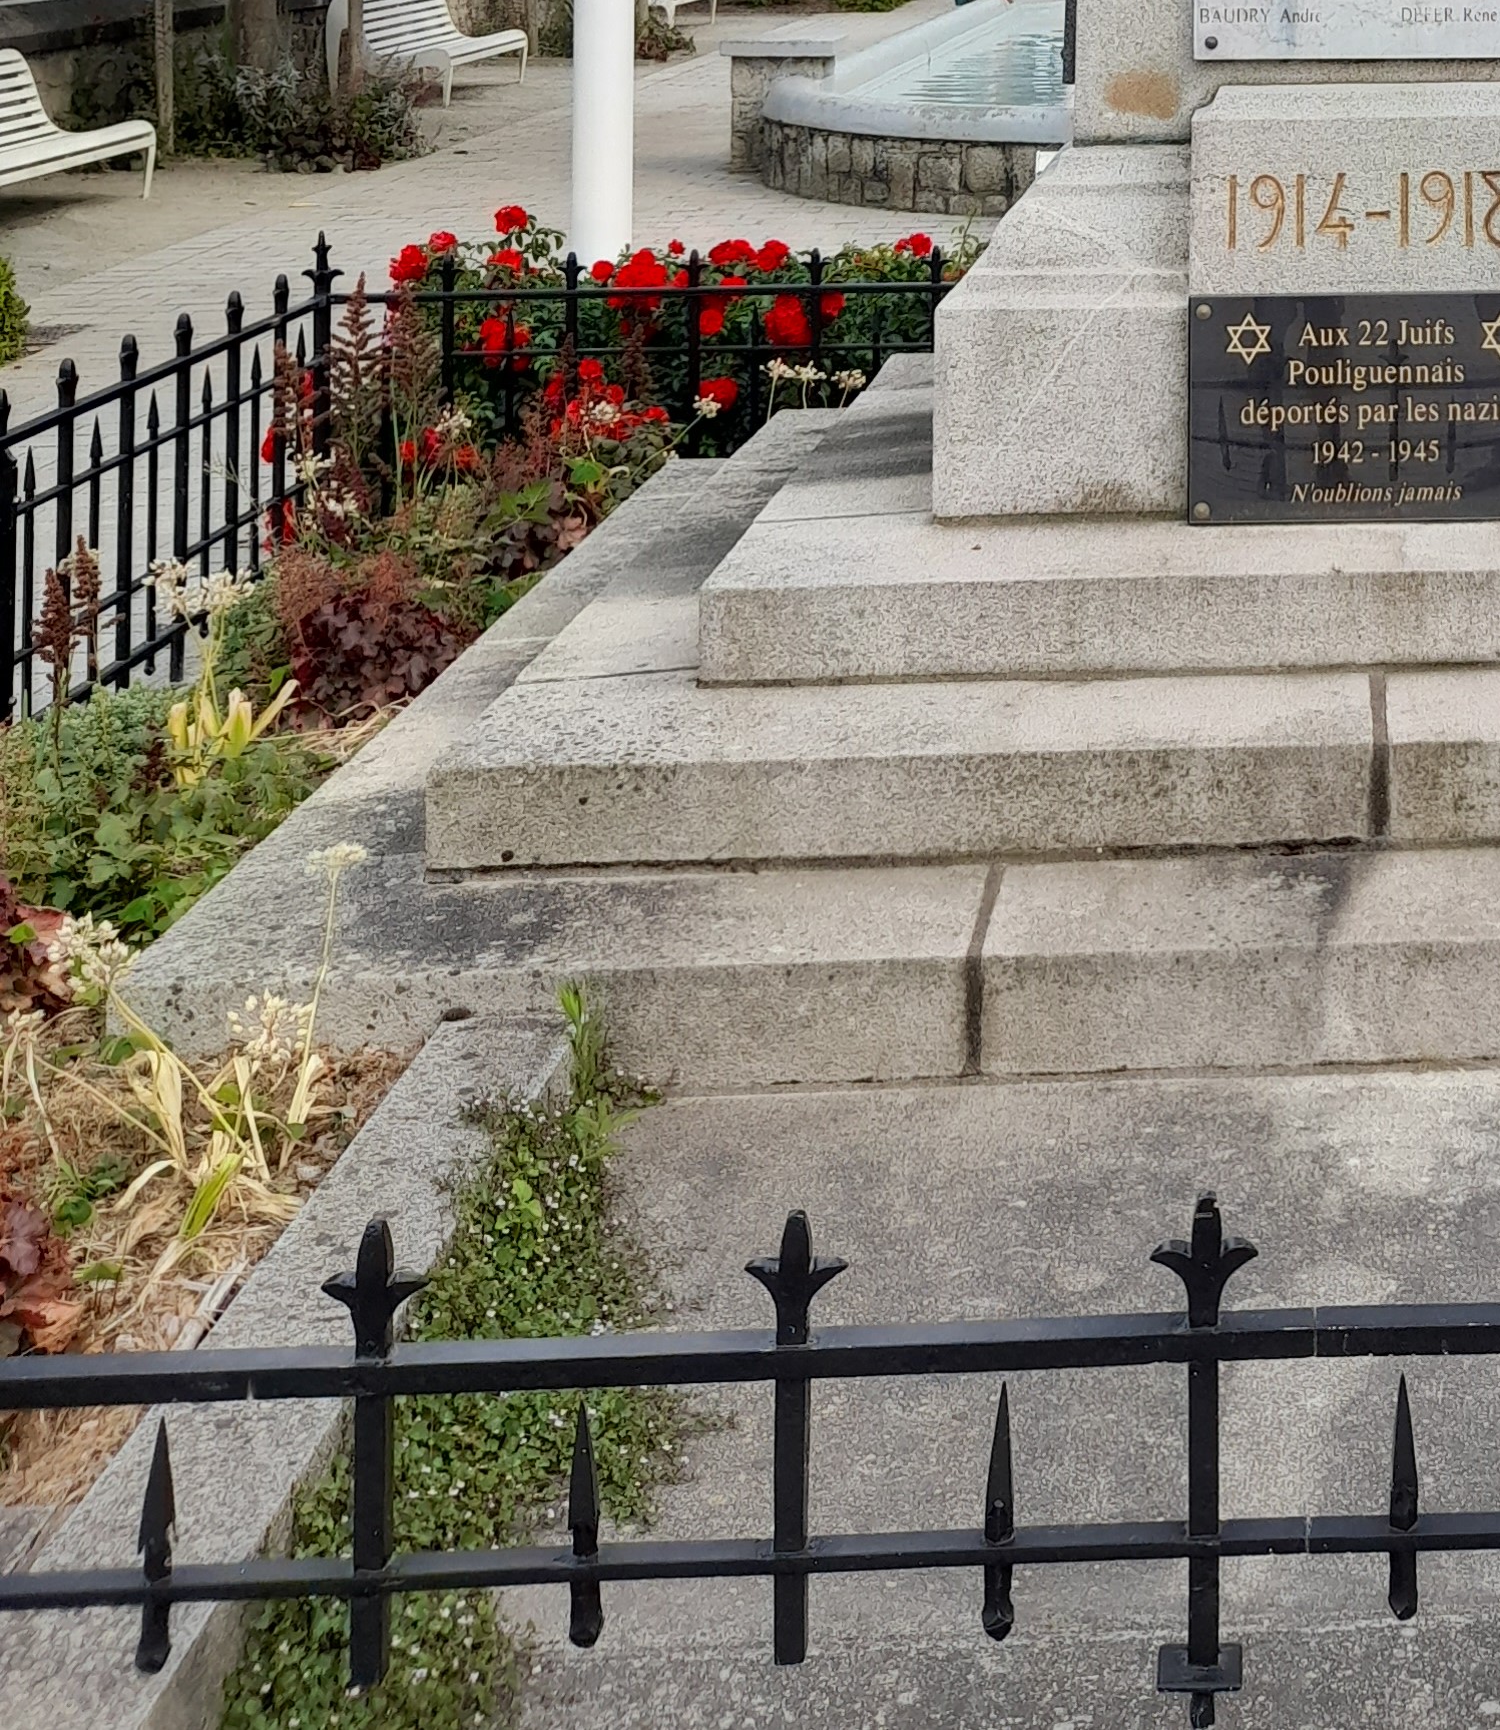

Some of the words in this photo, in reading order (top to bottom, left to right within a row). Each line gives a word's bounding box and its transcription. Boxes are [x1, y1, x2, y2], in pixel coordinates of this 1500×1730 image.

[1199, 8, 1271, 24] BAUDRY
[1401, 7, 1453, 22] DEFER
[1298, 322, 1350, 347] Aux
[1358, 321, 1388, 346] 22
[1396, 318, 1455, 347] Juifs
[1288, 358, 1465, 391] Pouliguennais
[1240, 399, 1349, 430] déportés
[1357, 403, 1398, 430] par
[1406, 396, 1439, 423] les
[1311, 440, 1364, 465] 1942
[1388, 439, 1440, 463] 1945
[1290, 482, 1393, 504] N'oublions
[1396, 480, 1462, 505] jamais
